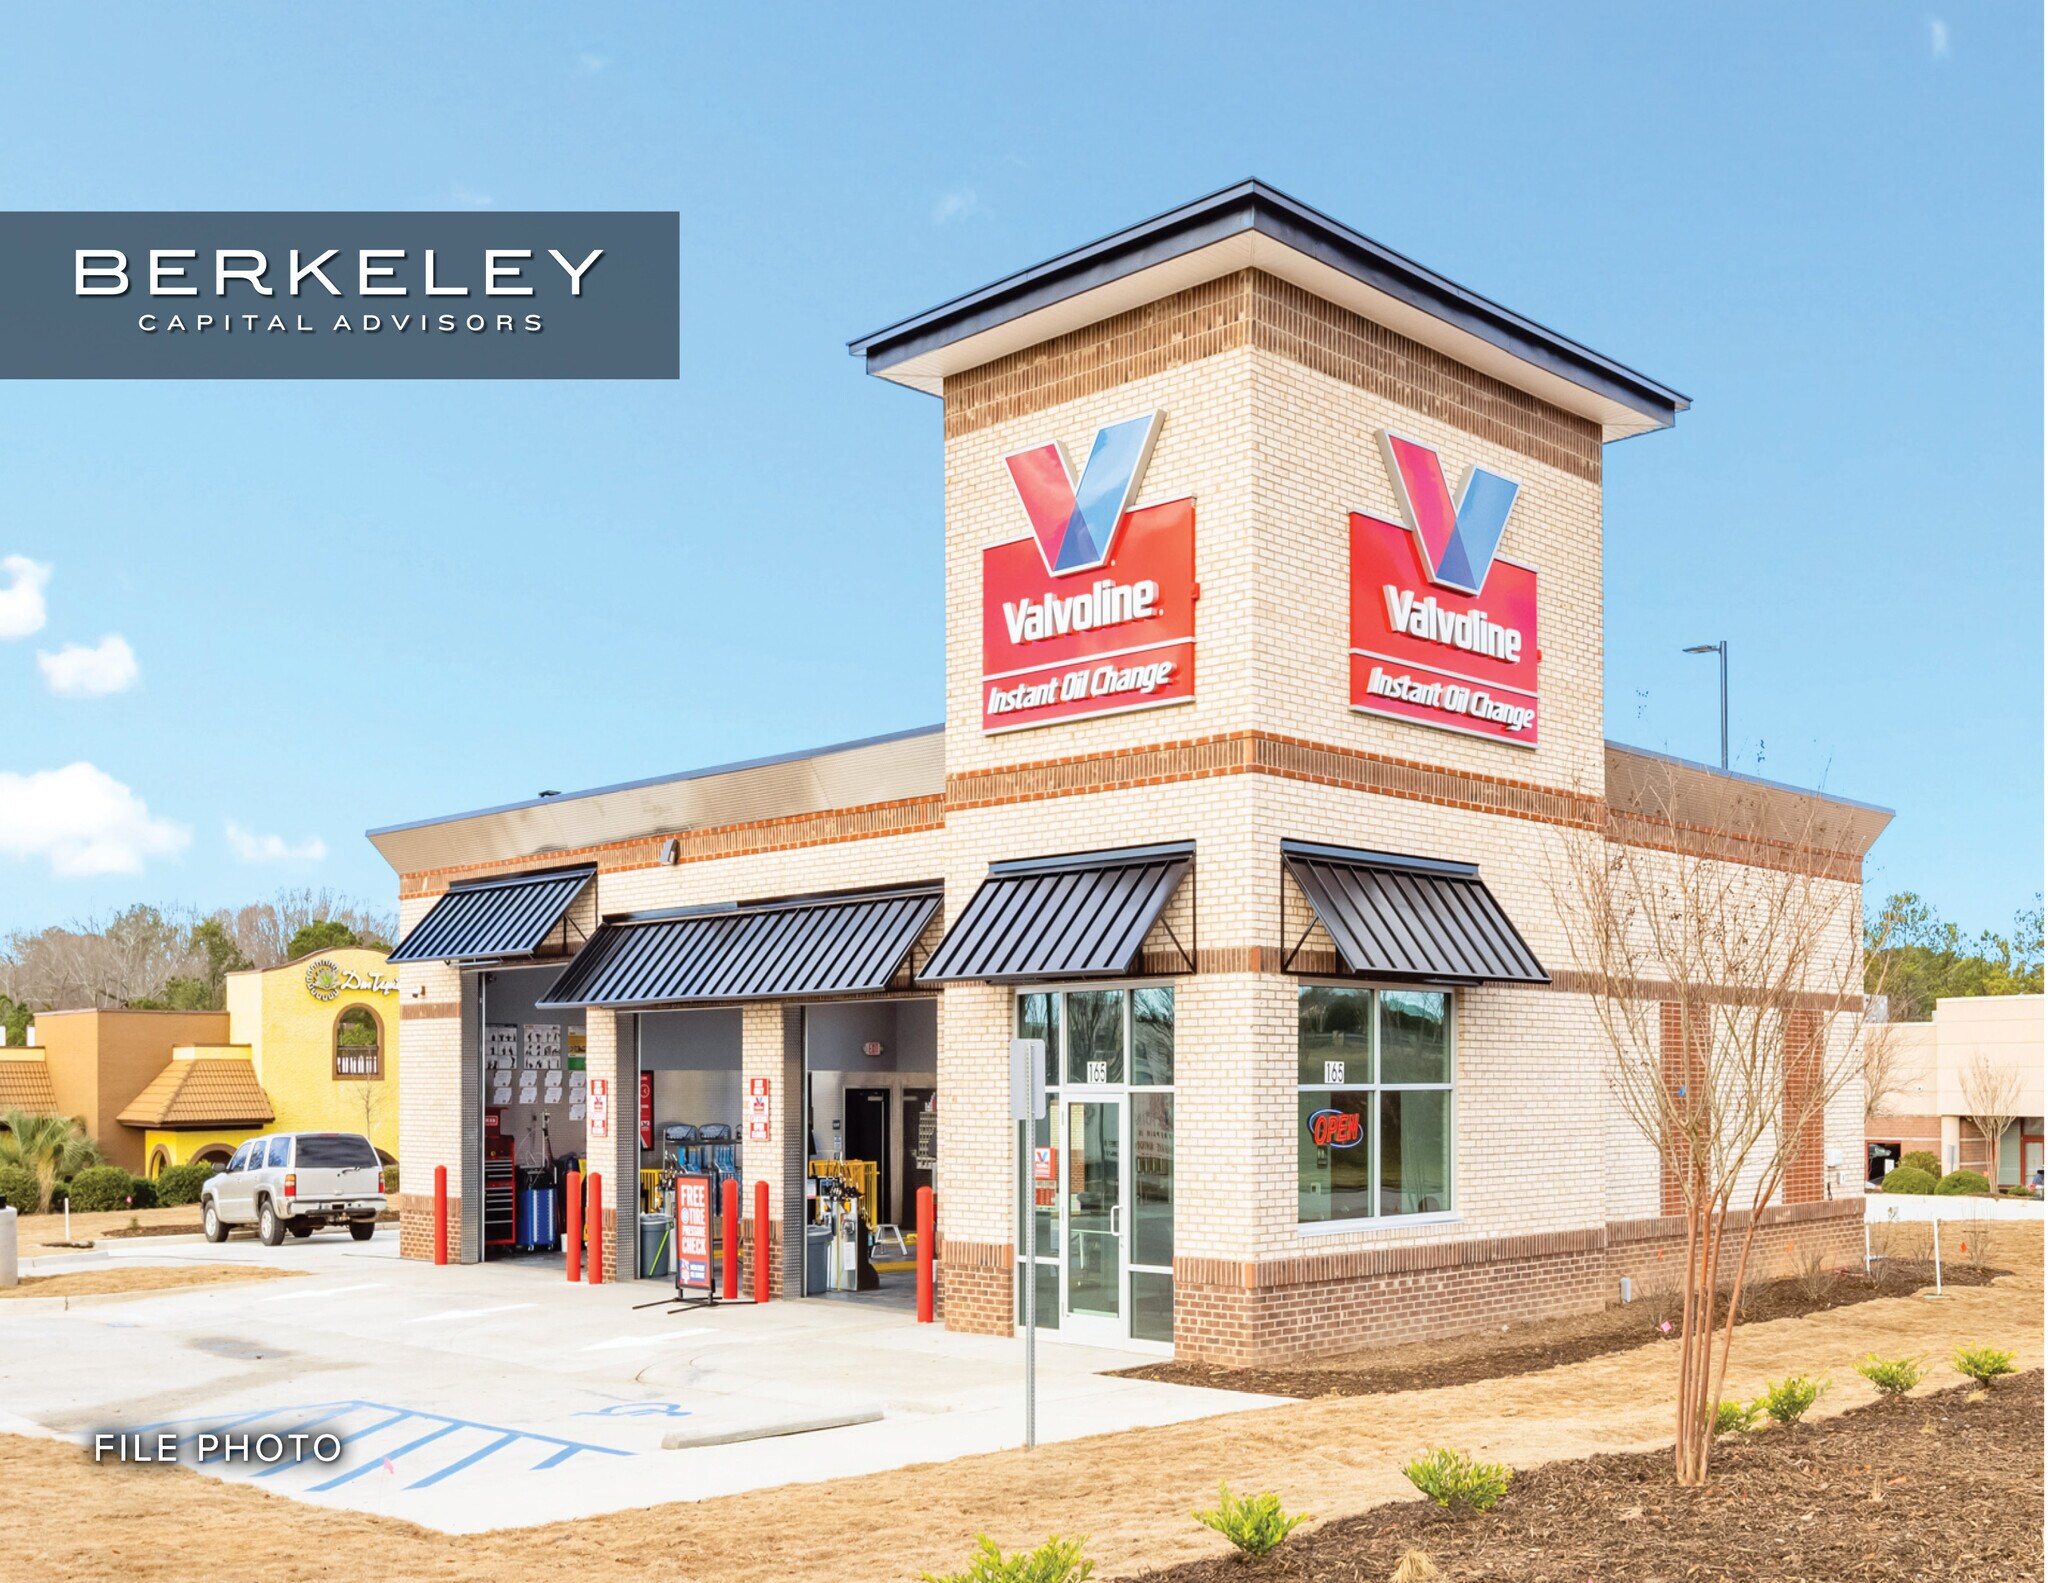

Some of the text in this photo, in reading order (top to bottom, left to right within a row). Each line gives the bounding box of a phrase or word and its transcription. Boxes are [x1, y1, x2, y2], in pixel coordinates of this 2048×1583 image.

[1003, 579, 1159, 644] Valvoline
[1382, 584, 1522, 663] Valvoline
[987, 661, 1176, 715] Instant Oil Change
[1366, 667, 1536, 732] Instant Oil Change
[1088, 1063, 1106, 1082] 165
[1326, 1063, 1344, 1082] 165
[1314, 1112, 1360, 1146] OPEN
[681, 1184, 706, 1208] FREE
[688, 1208, 706, 1225] TIRE
[682, 1237, 707, 1256] CHECK
